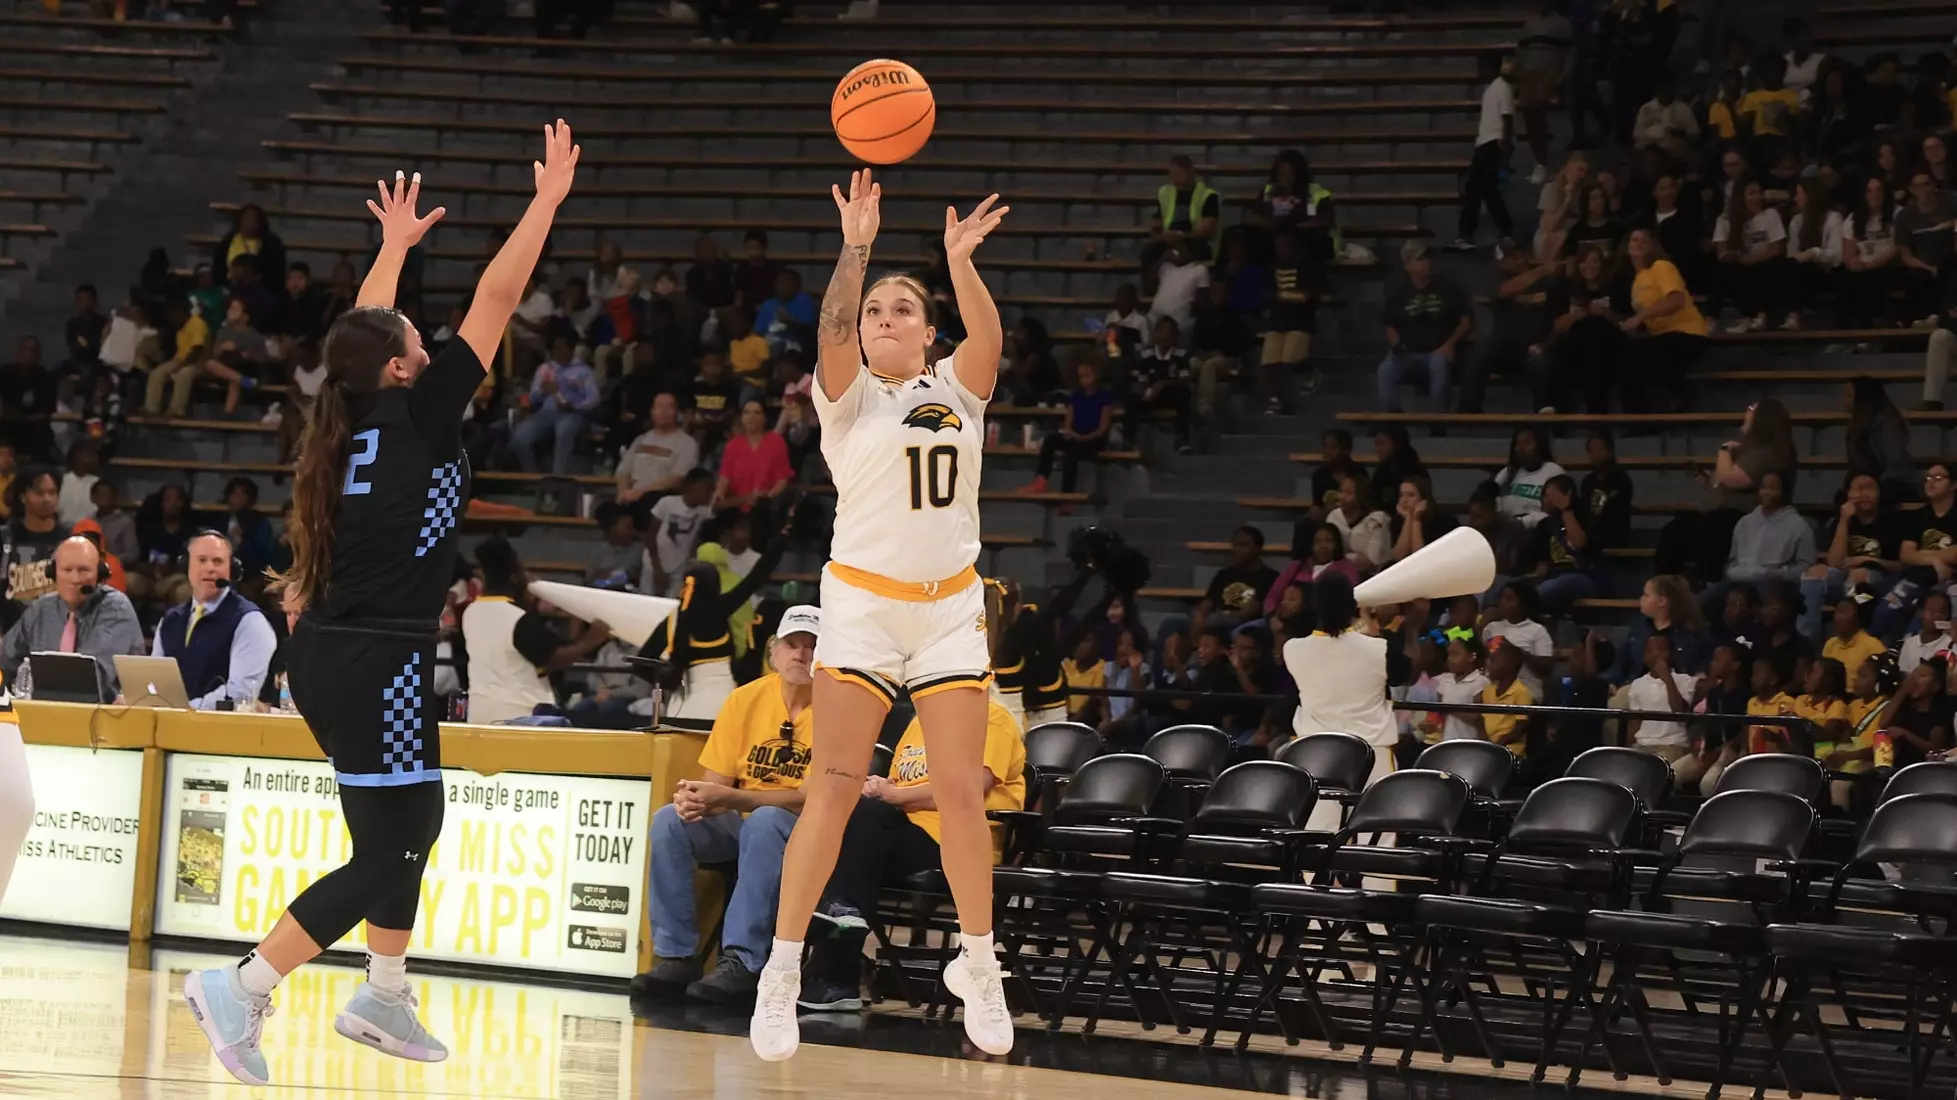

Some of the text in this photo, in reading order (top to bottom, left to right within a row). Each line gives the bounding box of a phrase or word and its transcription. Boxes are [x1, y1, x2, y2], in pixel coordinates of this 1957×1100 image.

[841, 71, 911, 100] Wilson
[342, 428, 381, 496] 2
[905, 444, 959, 511] 10
[243, 766, 261, 791] An
[266, 769, 310, 793] entire
[449, 783, 459, 803] a
[462, 780, 509, 811] single
[513, 789, 559, 813] game
[34, 811, 68, 830] CINE
[578, 799, 635, 830] GET IT
[19, 839, 123, 865] ISS ATHLETICS
[458, 819, 556, 880] MISS
[575, 833, 634, 865] TODAY
[582, 895, 628, 912] Google play
[453, 881, 551, 959] APP
[584, 935, 623, 950] App Store
